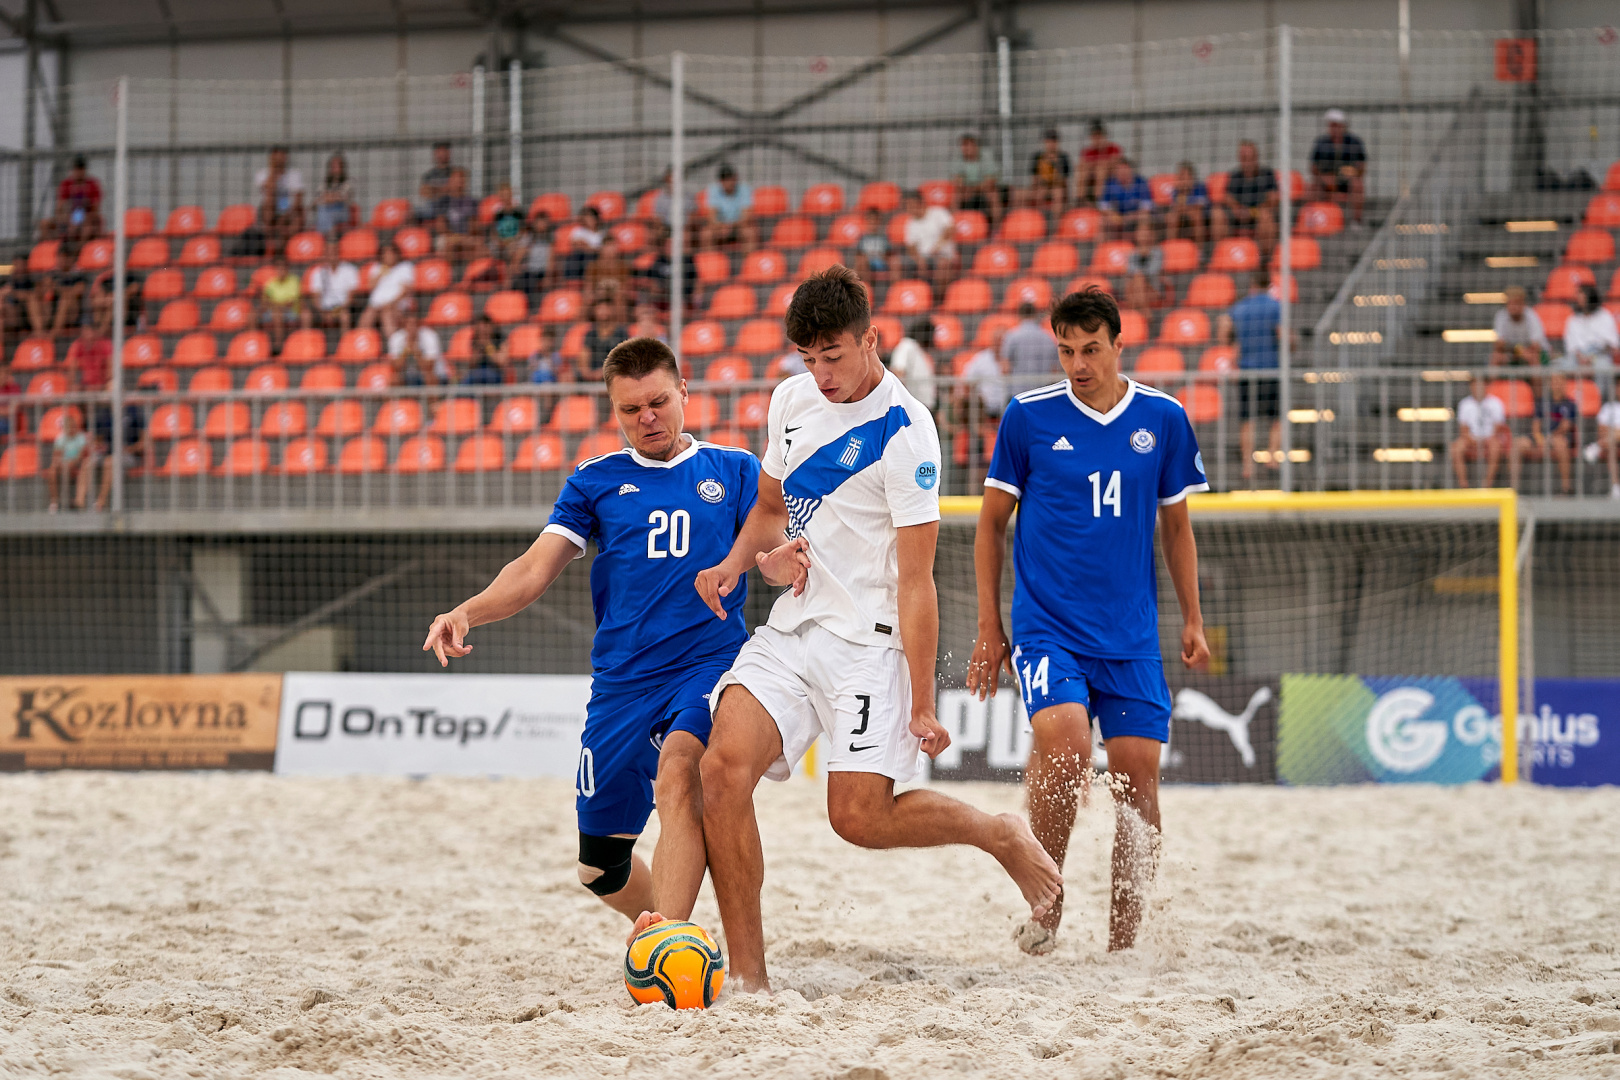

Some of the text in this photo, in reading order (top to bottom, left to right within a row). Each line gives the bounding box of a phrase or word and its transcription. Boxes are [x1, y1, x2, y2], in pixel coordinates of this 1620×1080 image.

[919, 466, 936, 475] ONE
[1087, 470, 1121, 517] 14
[647, 509, 691, 559] 20
[1022, 655, 1049, 704] 14
[10, 685, 248, 742] Kozlovna
[850, 694, 871, 735] 3
[577, 747, 596, 798] 0
[1481, 743, 1575, 768] SORTS
